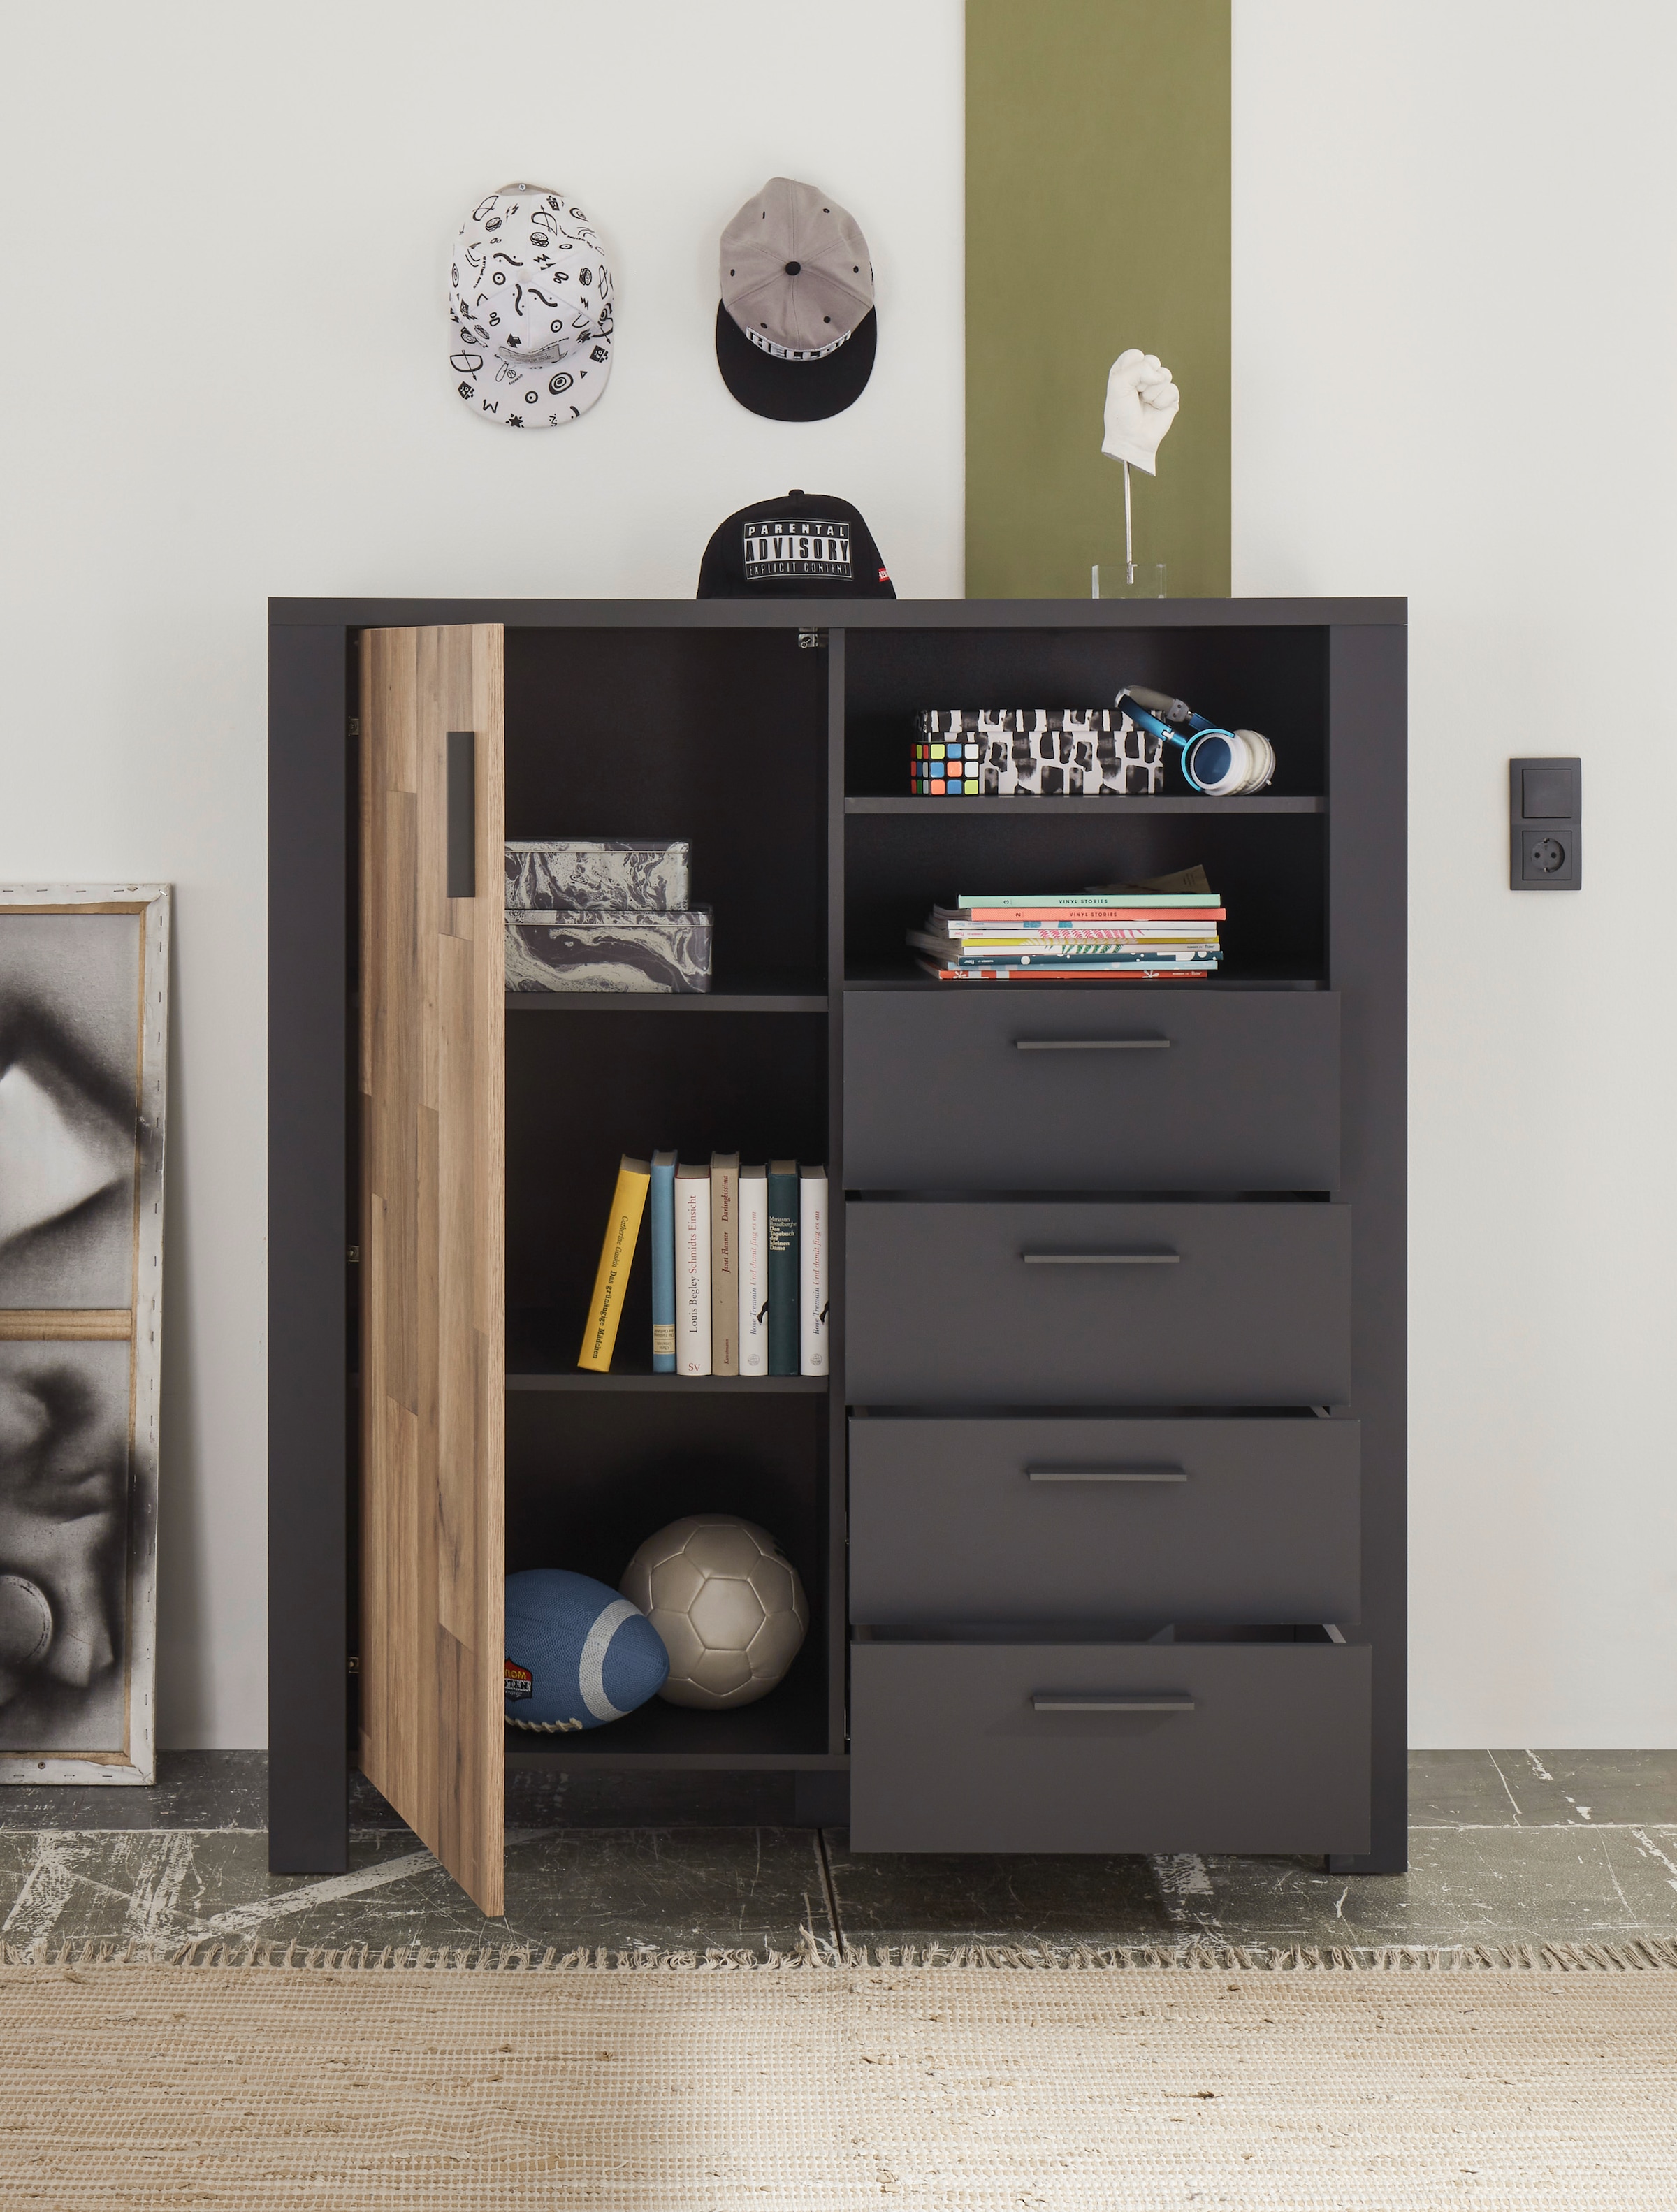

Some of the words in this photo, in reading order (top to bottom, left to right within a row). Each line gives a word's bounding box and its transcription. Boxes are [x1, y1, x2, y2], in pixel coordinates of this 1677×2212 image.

[748, 524, 845, 537] PARENTAL
[746, 537, 849, 562] ADVISORY
[749, 562, 797, 576] EXPLICIT
[804, 562, 848, 574] CONTENT
[688, 1195, 697, 1230] Einsicht
[751, 1211, 757, 1221] an
[814, 1211, 820, 1220] an
[616, 1216, 628, 1245] Catherine
[749, 1232, 759, 1247] fing
[812, 1232, 822, 1247] fing
[611, 1246, 622, 1267] Gaskin
[688, 1234, 697, 1274] Schmidts
[721, 1258, 731, 1273] Janet
[608, 1270, 617, 1284] Das
[688, 1276, 699, 1305] Begley
[599, 1285, 613, 1326] grünäugige
[688, 1308, 697, 1333] Louis
[593, 1327, 605, 1359] Mädchen
[688, 1363, 701, 1371] SV
